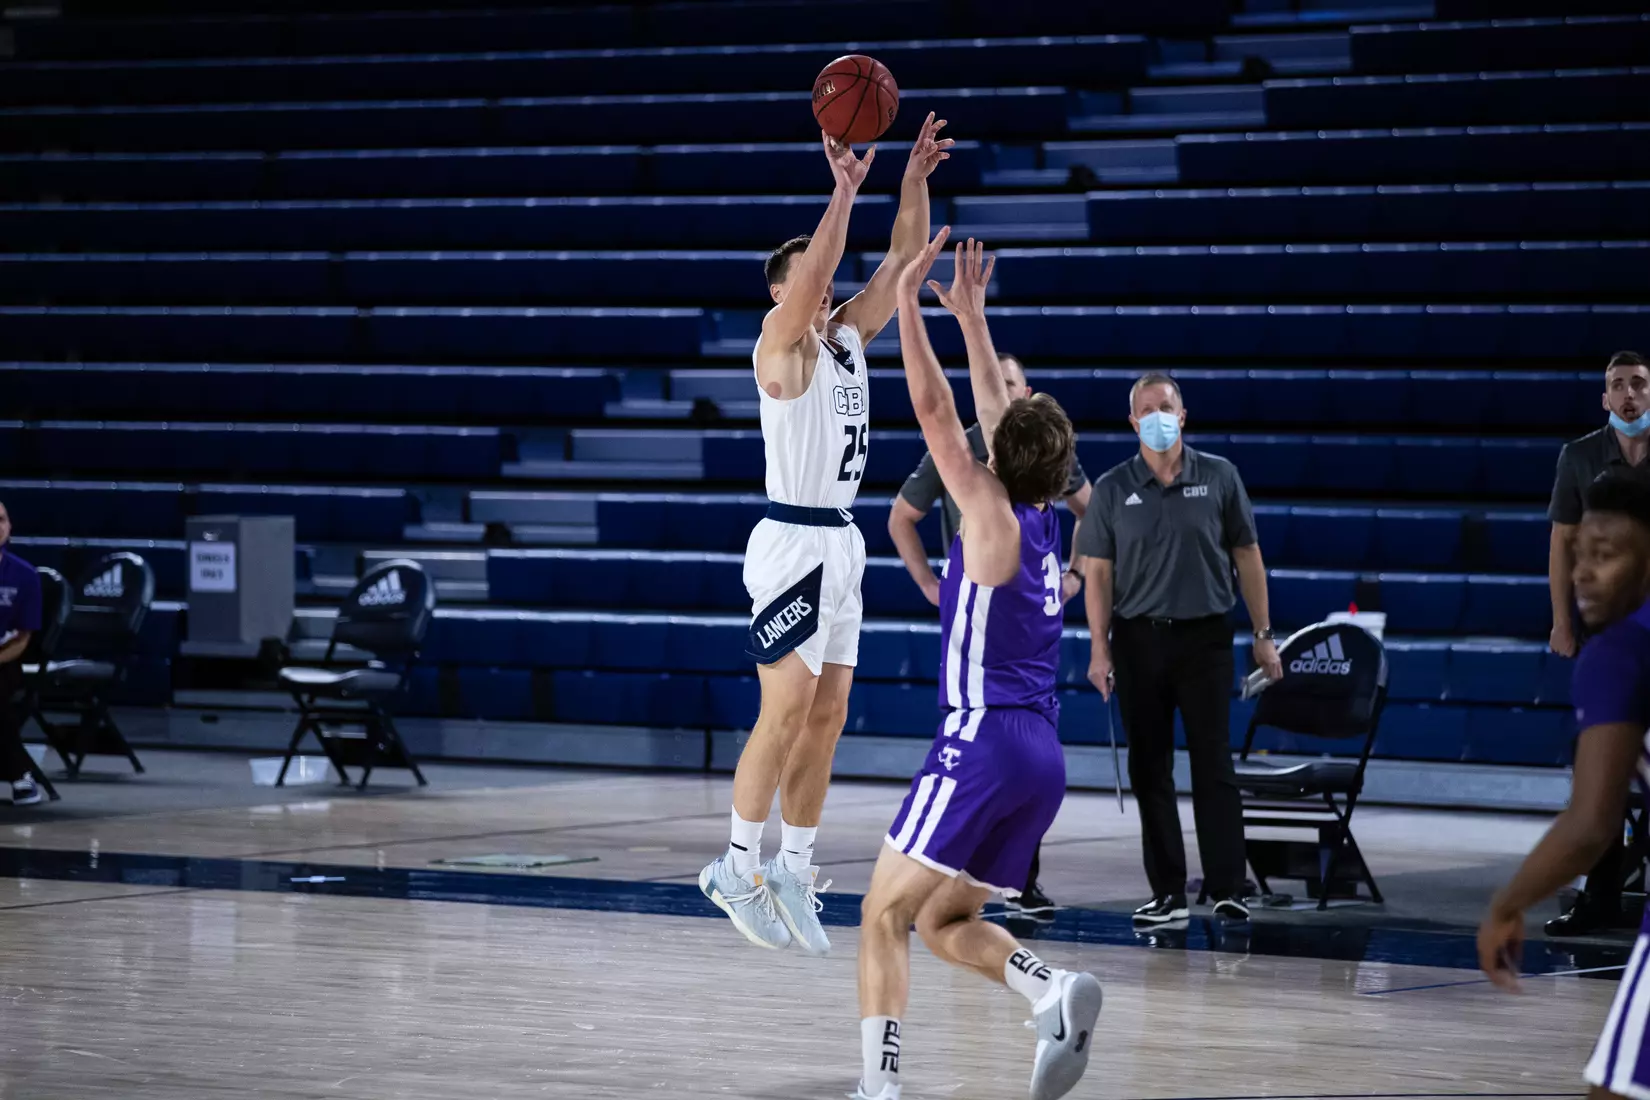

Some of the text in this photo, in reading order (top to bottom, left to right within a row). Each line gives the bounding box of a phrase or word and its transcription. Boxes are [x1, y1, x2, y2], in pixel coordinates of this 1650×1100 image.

[833, 385, 866, 417] CB
[1041, 551, 1061, 616] 3
[756, 595, 813, 649] LANCERS
[1290, 659, 1352, 675] adidas
